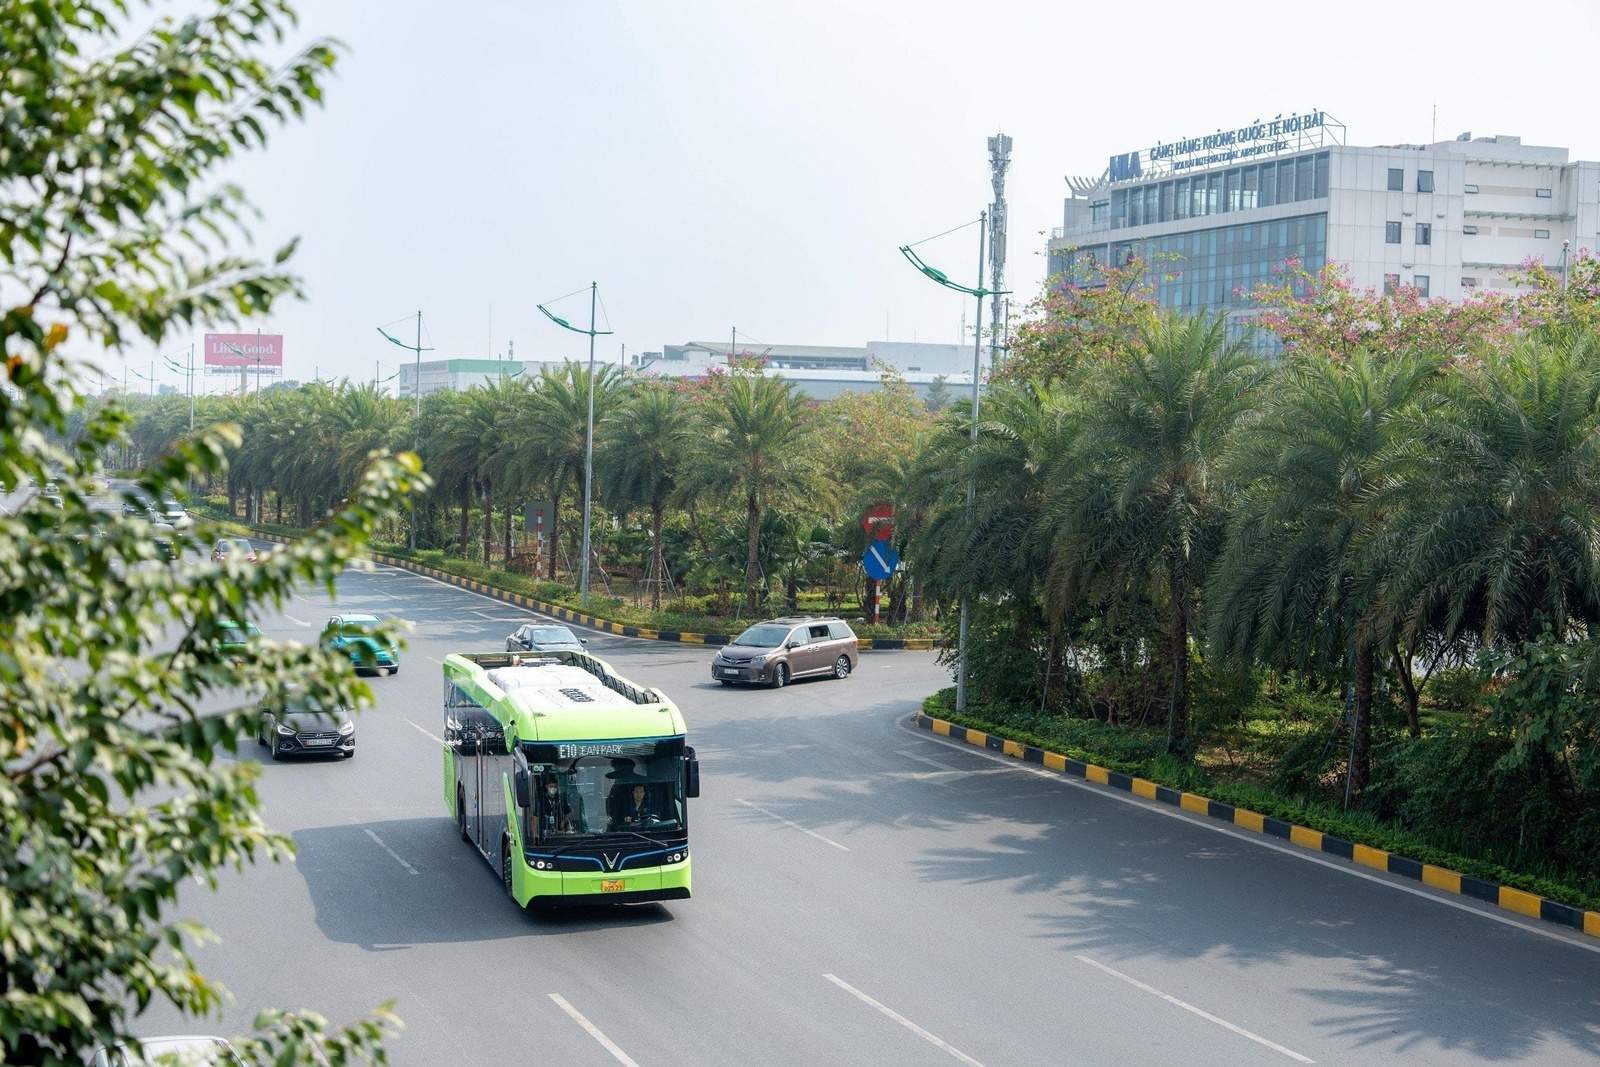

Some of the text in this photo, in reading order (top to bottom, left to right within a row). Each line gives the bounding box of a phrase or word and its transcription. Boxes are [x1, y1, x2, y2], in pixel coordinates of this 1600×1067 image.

[1150, 140, 1174, 160] CẢNG
[1175, 136, 1201, 155] HÀNG
[1203, 129, 1235, 150] KHÔNG
[1238, 118, 1266, 142] QUỐC
[1268, 113, 1281, 136] TẾ
[1304, 108, 1324, 129] BÀI
[1240, 144, 1266, 158] AIRPORT
[1266, 140, 1289, 153] OFFICE
[560, 744, 577, 758] E10
[600, 744, 623, 755] PARK
